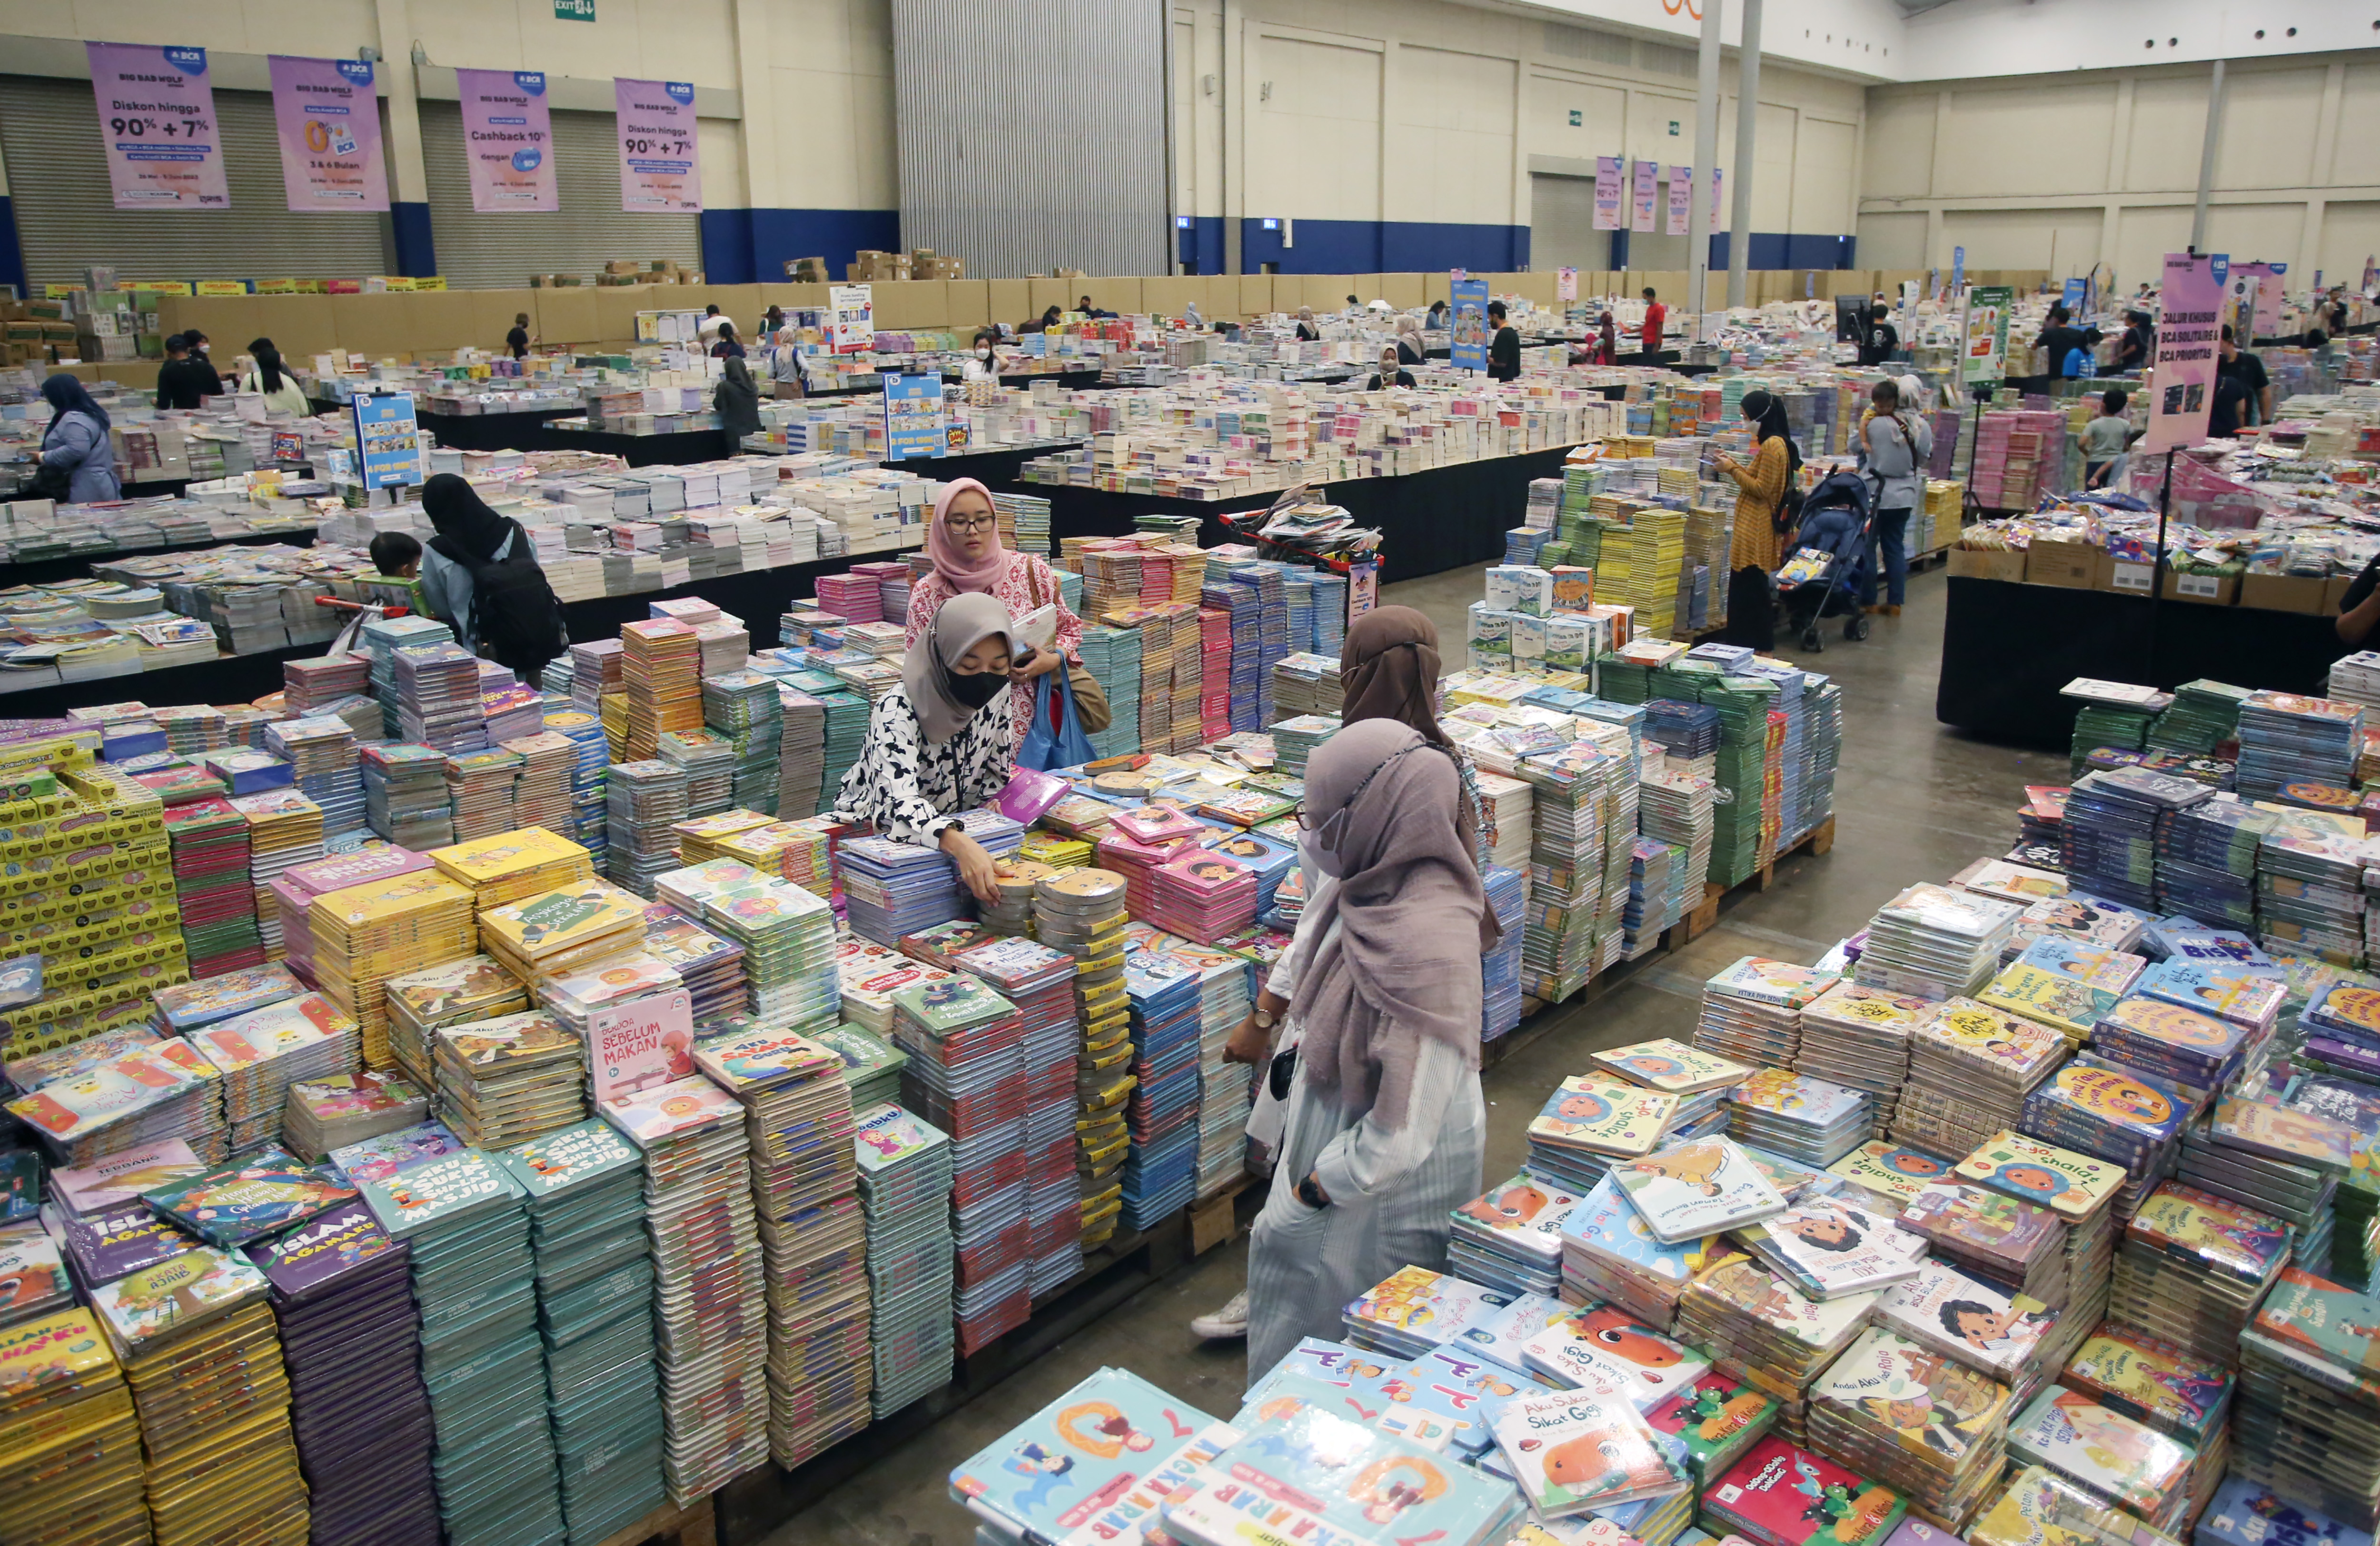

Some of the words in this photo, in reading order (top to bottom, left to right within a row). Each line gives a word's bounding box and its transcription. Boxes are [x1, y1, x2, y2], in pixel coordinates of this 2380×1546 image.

[555, 0, 575, 10] EXIT
[181, 51, 200, 61] BCA
[137, 74, 158, 82] BAD
[159, 75, 184, 83] WOLF
[351, 65, 368, 73] BCA
[112, 100, 156, 111] Diskon
[158, 102, 201, 115] hingga
[110, 118, 157, 137] 90%
[181, 119, 209, 138] 7%
[471, 131, 526, 141] Cashback
[628, 125, 657, 134] Diskon
[658, 126, 687, 137] hingga
[337, 141, 356, 154] BCA
[625, 139, 656, 154] 90%
[674, 140, 692, 155] 7%
[334, 161, 360, 170] Bulan
[480, 154, 510, 162] dengan
[2162, 313, 2187, 324] JALUR
[2189, 311, 2217, 324] KHUSUS
[2161, 331, 2177, 344] BCA
[2177, 329, 2213, 343] SOLITAIRE
[2159, 350, 2174, 363] BCA
[2175, 348, 2212, 361] PRIORITAS
[898, 437, 914, 446] FOR
[29, 754, 53, 764] POSTER
[524, 895, 576, 923] Asyiknya
[546, 903, 590, 928] SEKOLAH
[994, 946, 1006, 956] 10
[999, 948, 1034, 965] Muslim
[400, 976, 420, 985] Andai
[420, 975, 439, 983] Aku
[453, 964, 472, 977] Raja
[866, 971, 908, 986] Berapa
[1738, 989, 1755, 998] KETIKA
[1766, 995, 1782, 1004] SEDIH
[474, 1026, 494, 1034] Aku
[507, 1017, 527, 1030] Raja
[602, 1021, 661, 1050] SEBELUM
[604, 1035, 658, 1066] MAKAN
[721, 1036, 800, 1062] SAYANG
[751, 1047, 792, 1061] GURU
[2071, 1070, 2106, 1084] Tahu
[2092, 1077, 2125, 1092] Iman
[1597, 1110, 1634, 1139] shalat
[546, 1129, 614, 1162] SUKA
[548, 1129, 589, 1148] AKU
[557, 1138, 622, 1167] SHALAT
[97, 1155, 160, 1175] TERBANG
[416, 1159, 461, 1180] AKU
[545, 1147, 631, 1187] MASJID
[1851, 1160, 1904, 1184] shalat
[2040, 1157, 2100, 1183] shalat
[412, 1159, 486, 1191] SUKA
[422, 1169, 492, 1200] SHALAT
[216, 1180, 270, 1203] Mengenal
[236, 1186, 277, 1205] Hewan
[404, 1179, 500, 1223] MASJID
[229, 1197, 272, 1215] Ciptaan
[1657, 1201, 1690, 1218] Bermain
[1691, 1197, 1724, 1207] Taman
[1578, 1204, 1597, 1224] ADVENTURE
[1593, 1207, 1611, 1226] That
[269, 1213, 369, 1257] ISLAM
[1581, 1225, 1600, 1240] Go
[284, 1220, 376, 1265] AGAMAKU
[1826, 1258, 1860, 1272] BILANG
[1854, 1264, 1879, 1277] AKU
[1862, 1255, 1883, 1267] BISA
[150, 1269, 190, 1290] AJAIB
[155, 1263, 187, 1279] KATA
[1910, 1291, 1927, 1308] BISA
[1923, 1275, 1943, 1296] BILANG
[1800, 1302, 1818, 1322] Raja
[1562, 1345, 1594, 1365] Gigi
[1883, 1349, 1897, 1371] Raja
[1555, 1354, 1587, 1377] Suka
[1595, 1360, 1631, 1385] Sikat
[1832, 1381, 1858, 1391] Andai
[1858, 1375, 1881, 1389] Aku
[1879, 1370, 1892, 1383] Jadi
[1524, 1400, 1552, 1416] Aku
[1552, 1393, 1591, 1410] Suka
[1741, 1400, 1767, 1422] Kelinci
[1527, 1415, 1569, 1429] Sikat
[1568, 1403, 1605, 1422] Gigi
[2046, 1406, 2067, 1423] PIPI
[2054, 1423, 2077, 1445] SEDIH
[2043, 1462, 2069, 1480] KETIKA
[2069, 1475, 2086, 1489] PIPI
[1214, 1483, 1292, 1526] ARAB
[1879, 1497, 1895, 1522] Kelinci
[2020, 1489, 2035, 1518] Petani
[2028, 1529, 2043, 1546] Aku
